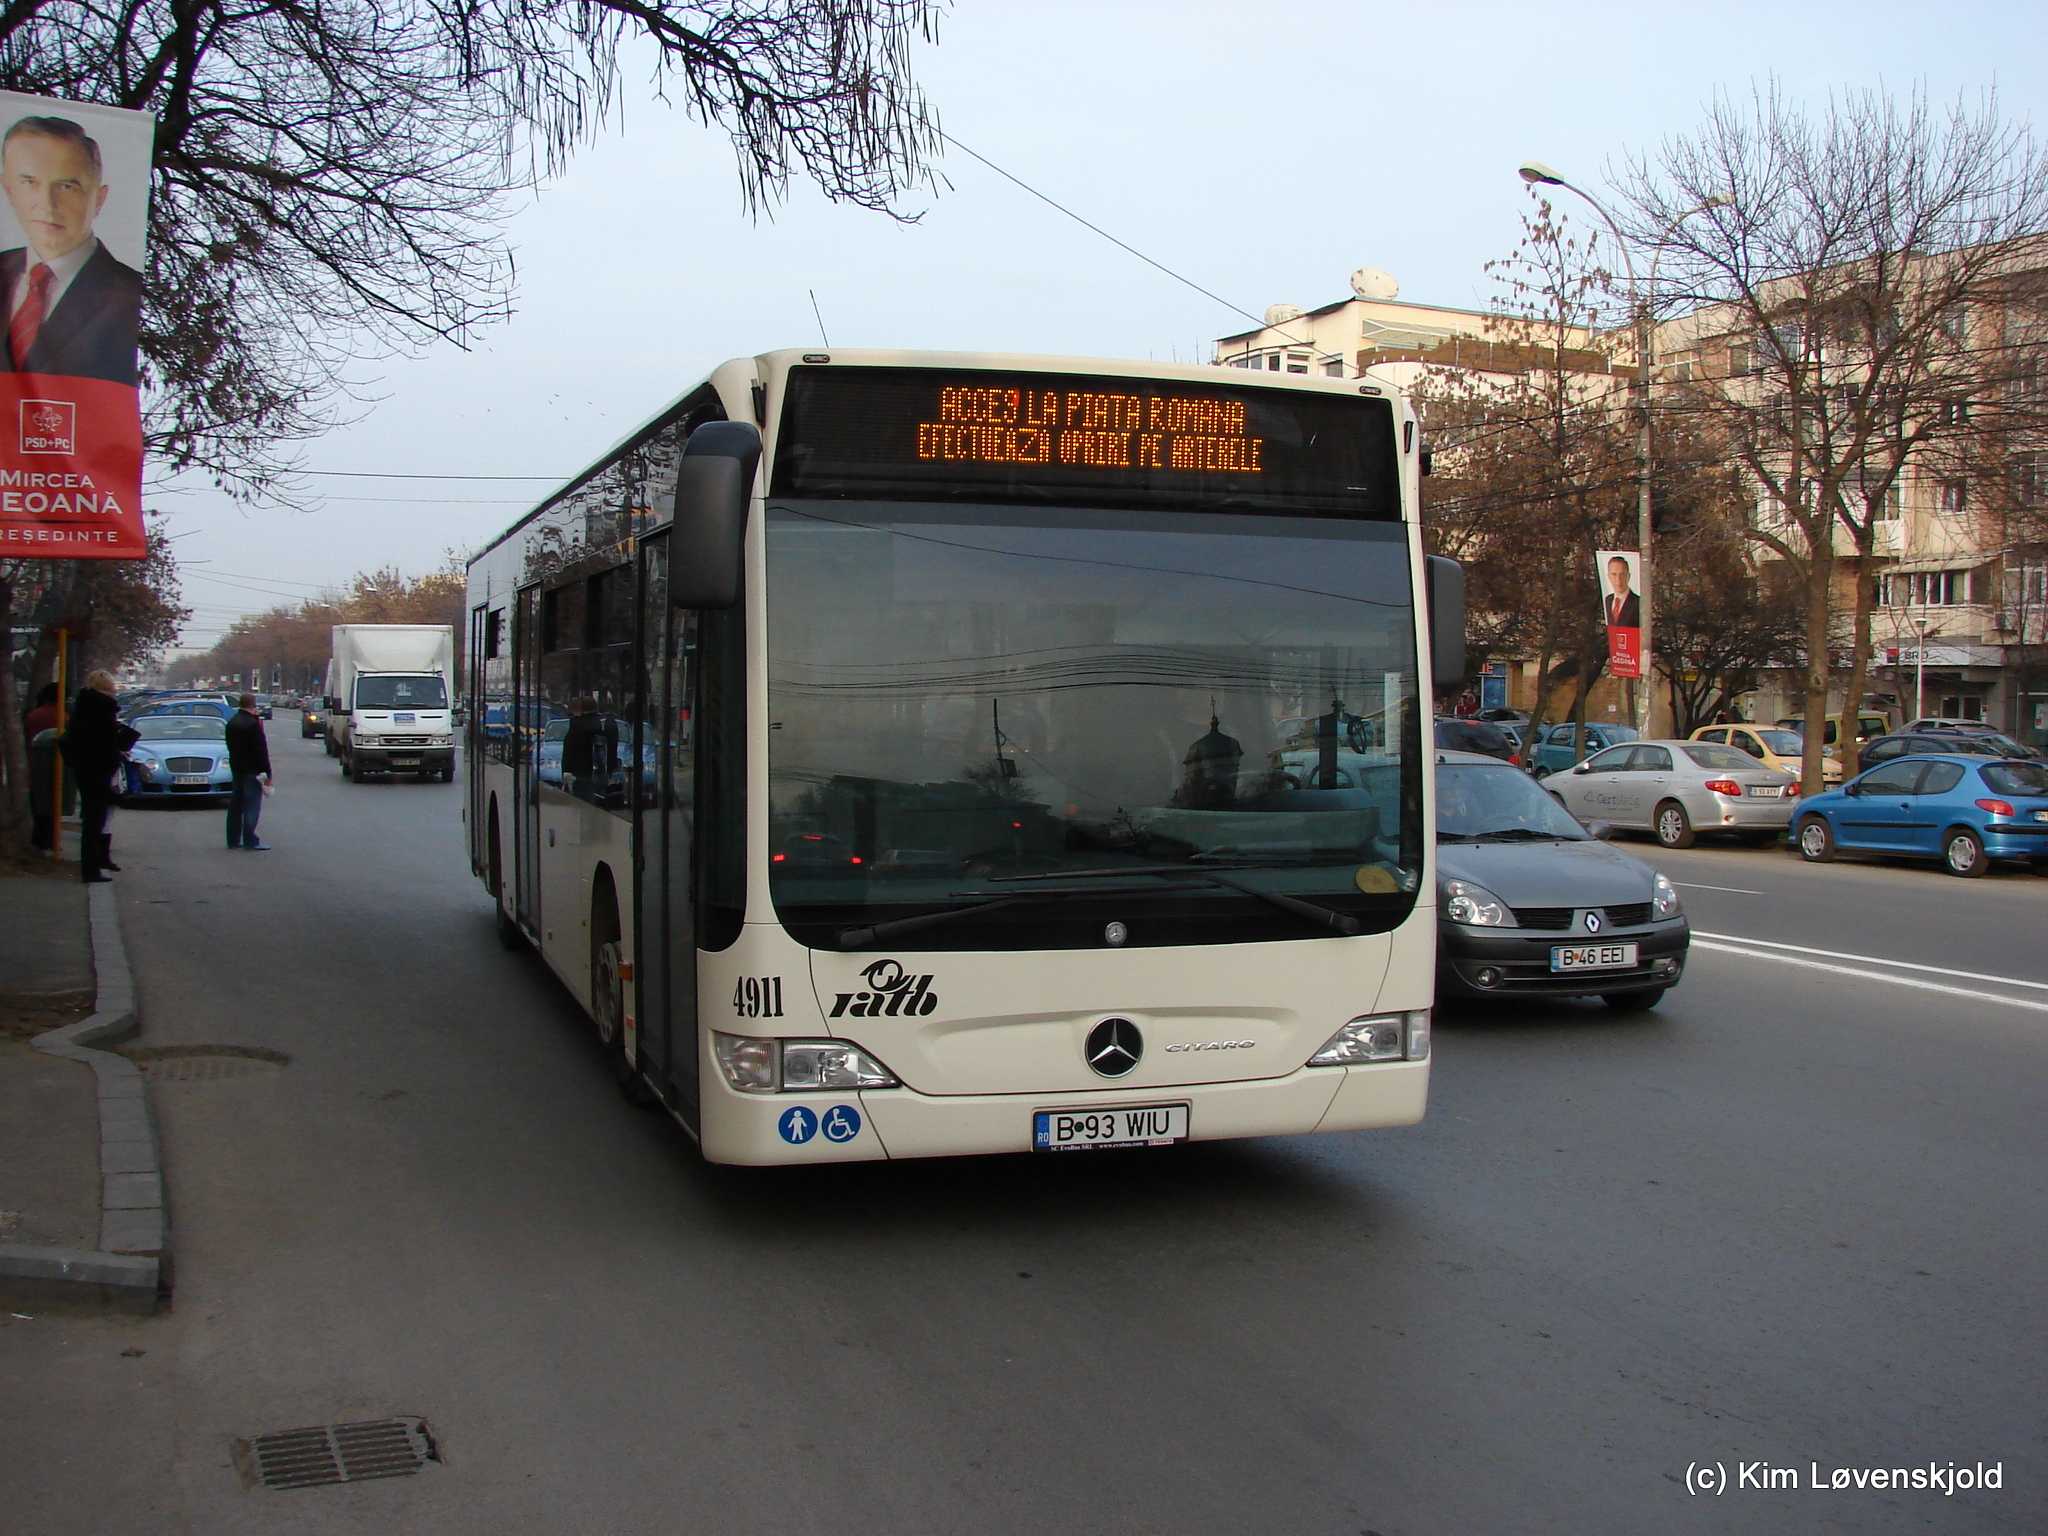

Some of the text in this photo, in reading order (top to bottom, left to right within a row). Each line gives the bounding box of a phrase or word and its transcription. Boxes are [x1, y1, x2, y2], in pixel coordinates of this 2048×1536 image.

[942, 387, 1245, 434] ACCES LA PIATA ROMANA
[25, 437, 70, 449] PSD+PC
[919, 423, 1264, 471] EFECTUEAZA OPRIRI PE ARTERELE
[0, 470, 95, 488] MIRCEA
[2, 491, 123, 514] EOANĂ
[1563, 947, 1624, 965] B 46 EEI
[733, 976, 784, 1018] 4911
[1165, 1039, 1255, 1052] CITARO
[1057, 1111, 1170, 1141] B 93 WIU
[1037, 1132, 1049, 1143] RO
